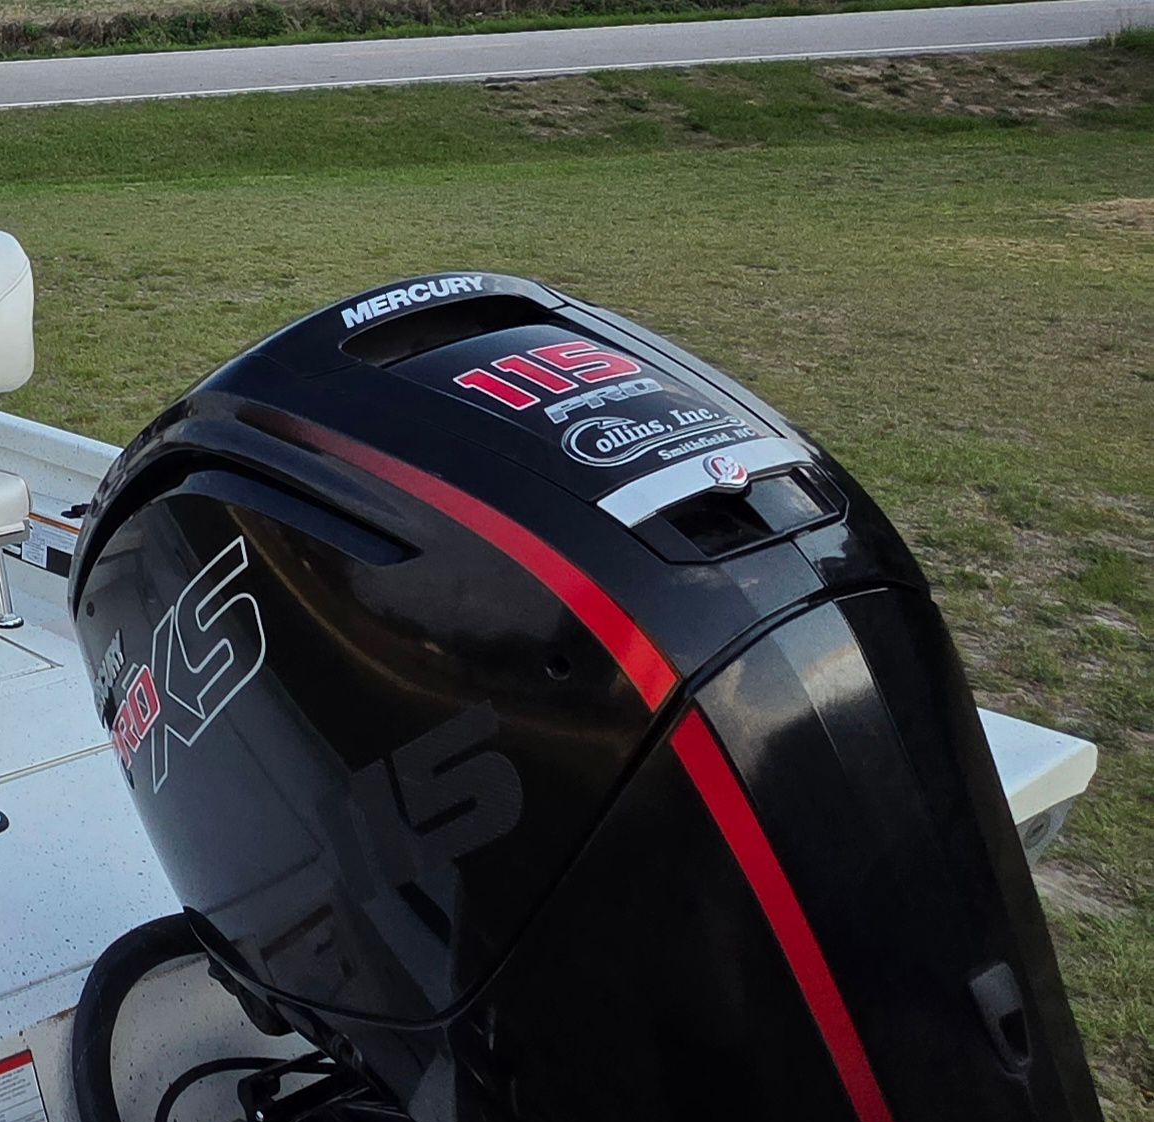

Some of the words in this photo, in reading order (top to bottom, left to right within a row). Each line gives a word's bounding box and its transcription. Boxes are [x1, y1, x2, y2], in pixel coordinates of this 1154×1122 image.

[341, 276, 483, 328] MERCURY
[453, 341, 641, 410] 115
[544, 378, 663, 424] PRO
[669, 406, 720, 426] Inc.
[657, 432, 735, 461] Smithfield,
[737, 425, 757, 440] NC
[111, 664, 161, 770] RO
[151, 535, 266, 794] XS
